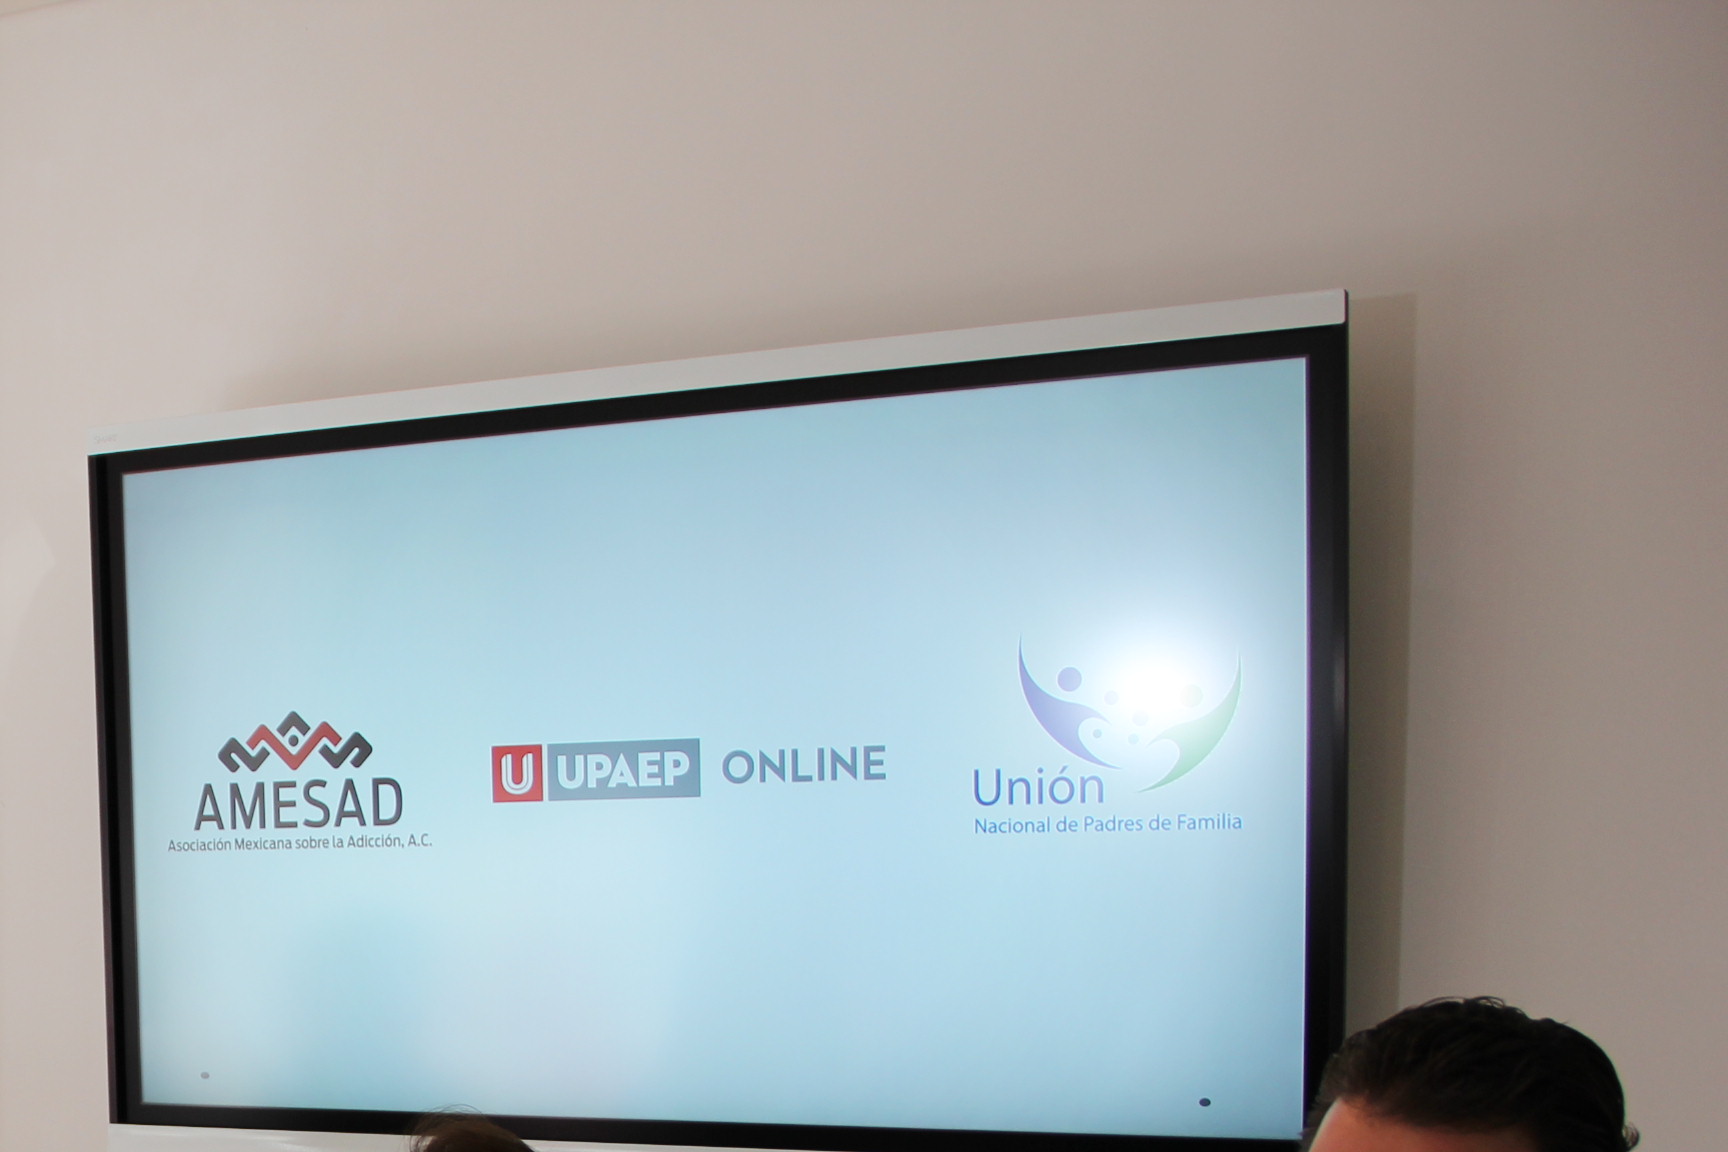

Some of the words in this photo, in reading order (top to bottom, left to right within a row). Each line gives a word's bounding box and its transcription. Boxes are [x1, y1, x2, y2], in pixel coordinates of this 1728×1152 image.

[556, 750, 691, 791] UPAEP
[722, 745, 887, 784] ONLINE
[973, 765, 1104, 807] Unión
[194, 777, 403, 830] AMESAD
[974, 815, 1051, 835] Nacional
[1055, 815, 1079, 833] de
[1084, 814, 1144, 833] Padres
[1148, 814, 1172, 831] de
[1177, 812, 1243, 831] Familia
[168, 837, 232, 852] Asociación
[235, 836, 292, 850] Mexicana
[295, 835, 330, 850] sobre
[332, 835, 344, 849] la
[347, 833, 405, 849] Adicción,
[407, 833, 433, 848] A.C.
